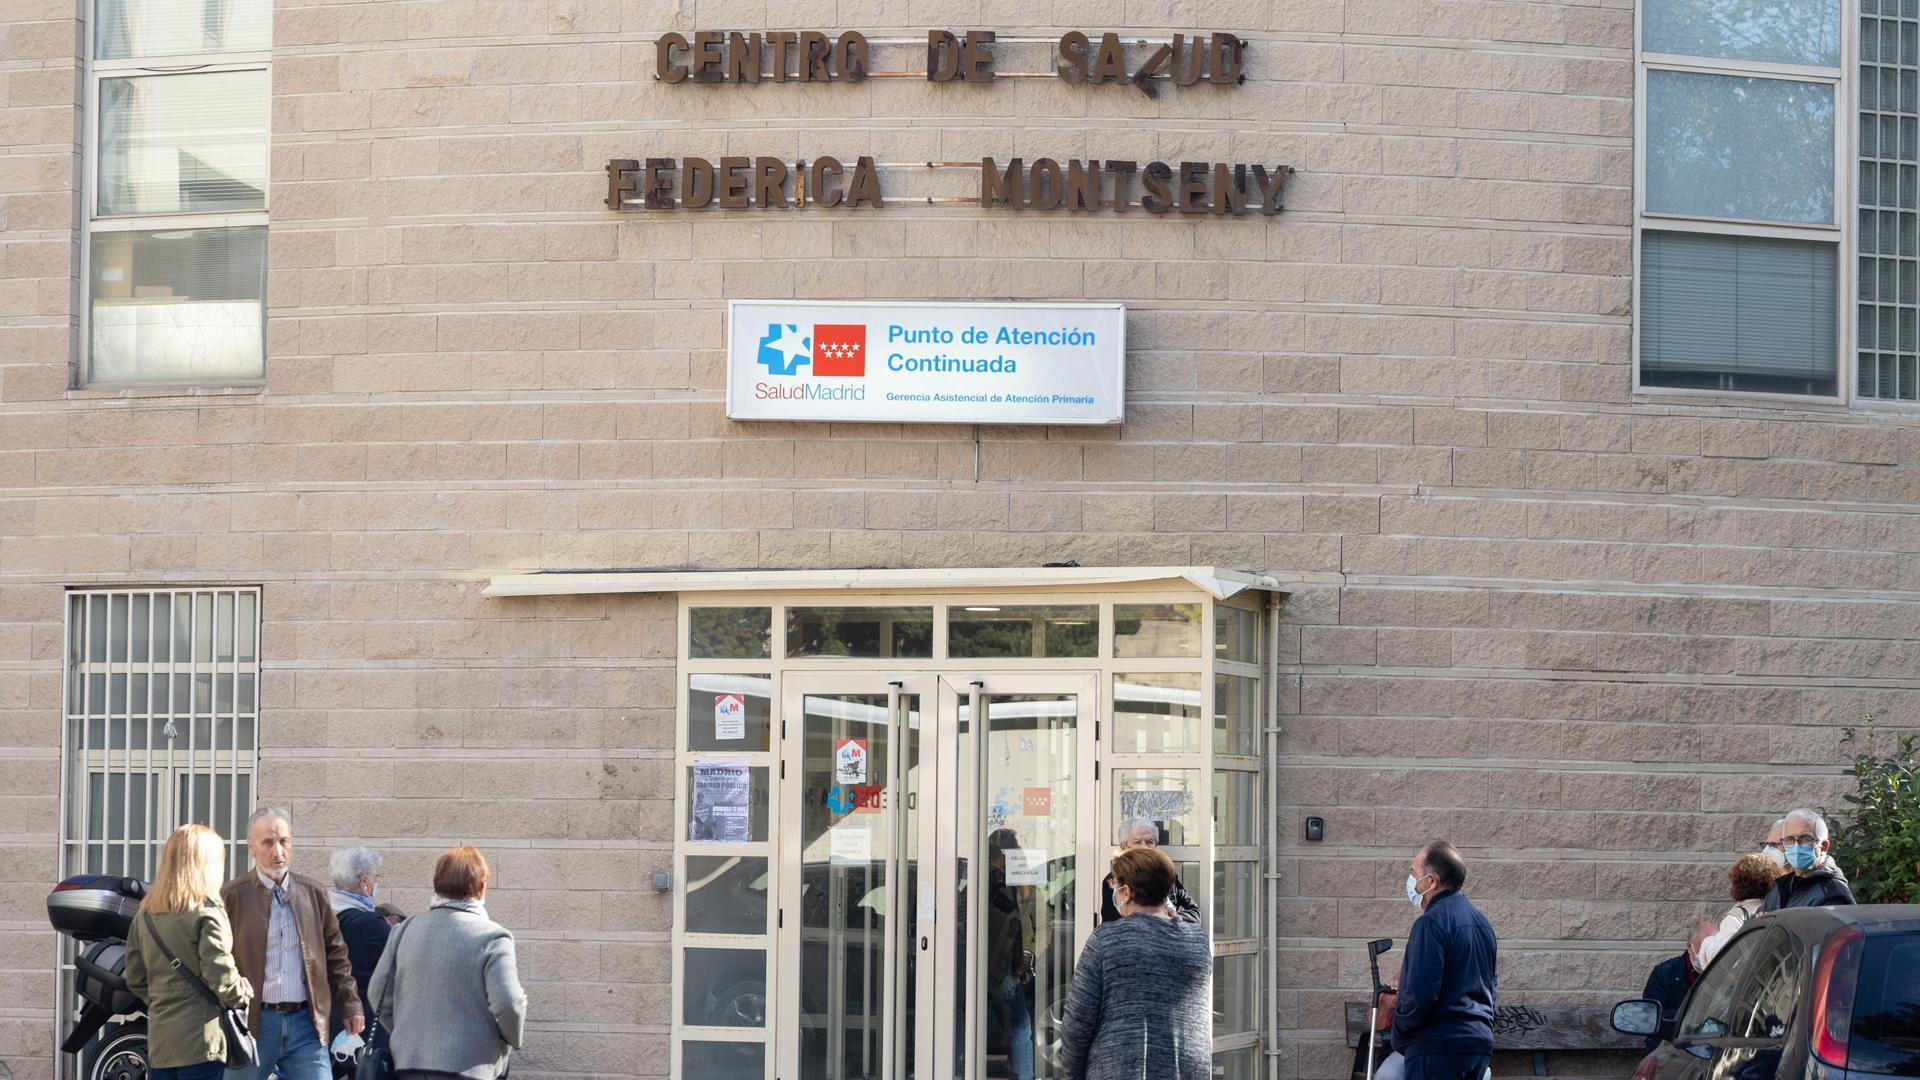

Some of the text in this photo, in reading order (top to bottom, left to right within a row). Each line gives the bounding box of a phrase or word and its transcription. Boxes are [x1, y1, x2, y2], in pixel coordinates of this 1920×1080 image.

[656, 30, 1244, 99] CENTRO DE SALUD
[607, 155, 1289, 216] FEDERICA MONTSENY
[888, 325, 1096, 346] Punto de Atención
[887, 353, 1017, 374] Continuada
[755, 382, 866, 401] SaludMadrid
[886, 392, 1095, 405] Gerencia Asistencial de Atención Primaria
[700, 768, 743, 776] MADRID
